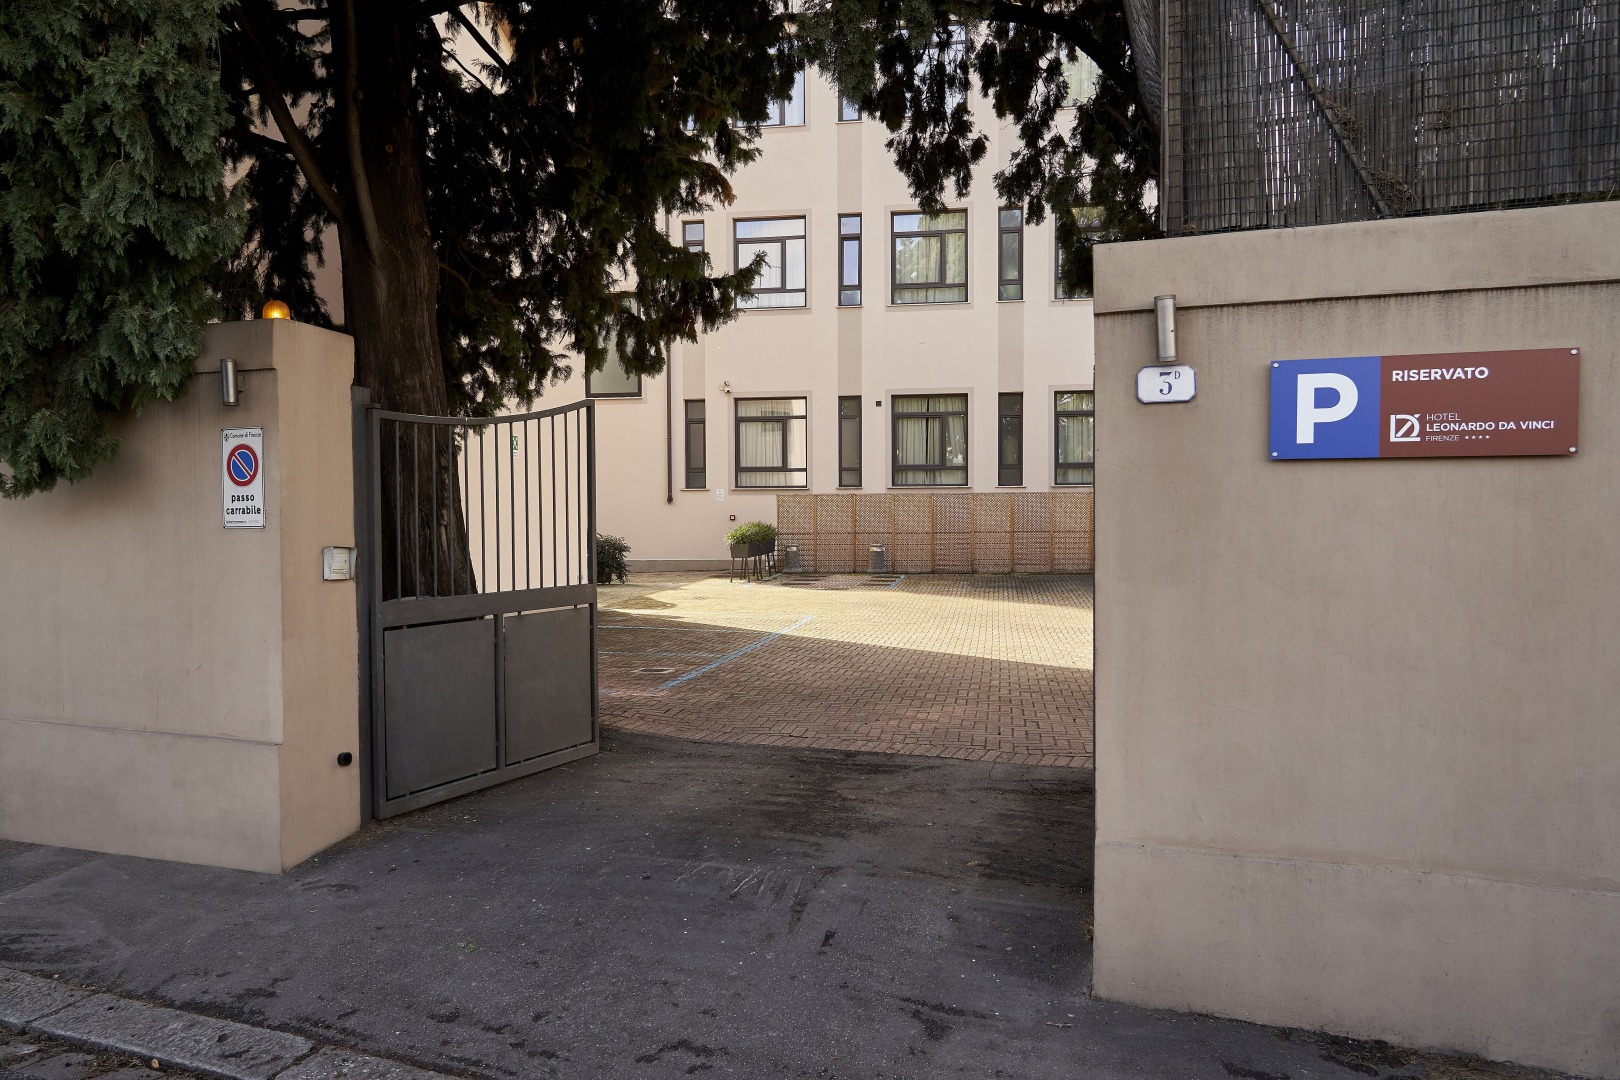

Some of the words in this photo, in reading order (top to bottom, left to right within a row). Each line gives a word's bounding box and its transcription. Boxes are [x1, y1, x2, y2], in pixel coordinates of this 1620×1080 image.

[1391, 366, 1489, 382] RISERVATO
[1296, 372, 1359, 444] P
[1426, 412, 1462, 421] HOTEL
[1426, 421, 1495, 432] LEONARDO
[1498, 421, 1517, 430] DA
[1519, 420, 1555, 429] VINCI
[1425, 434, 1460, 442] FIRENZE
[231, 494, 255, 503] passo
[226, 505, 262, 515] carrabile
